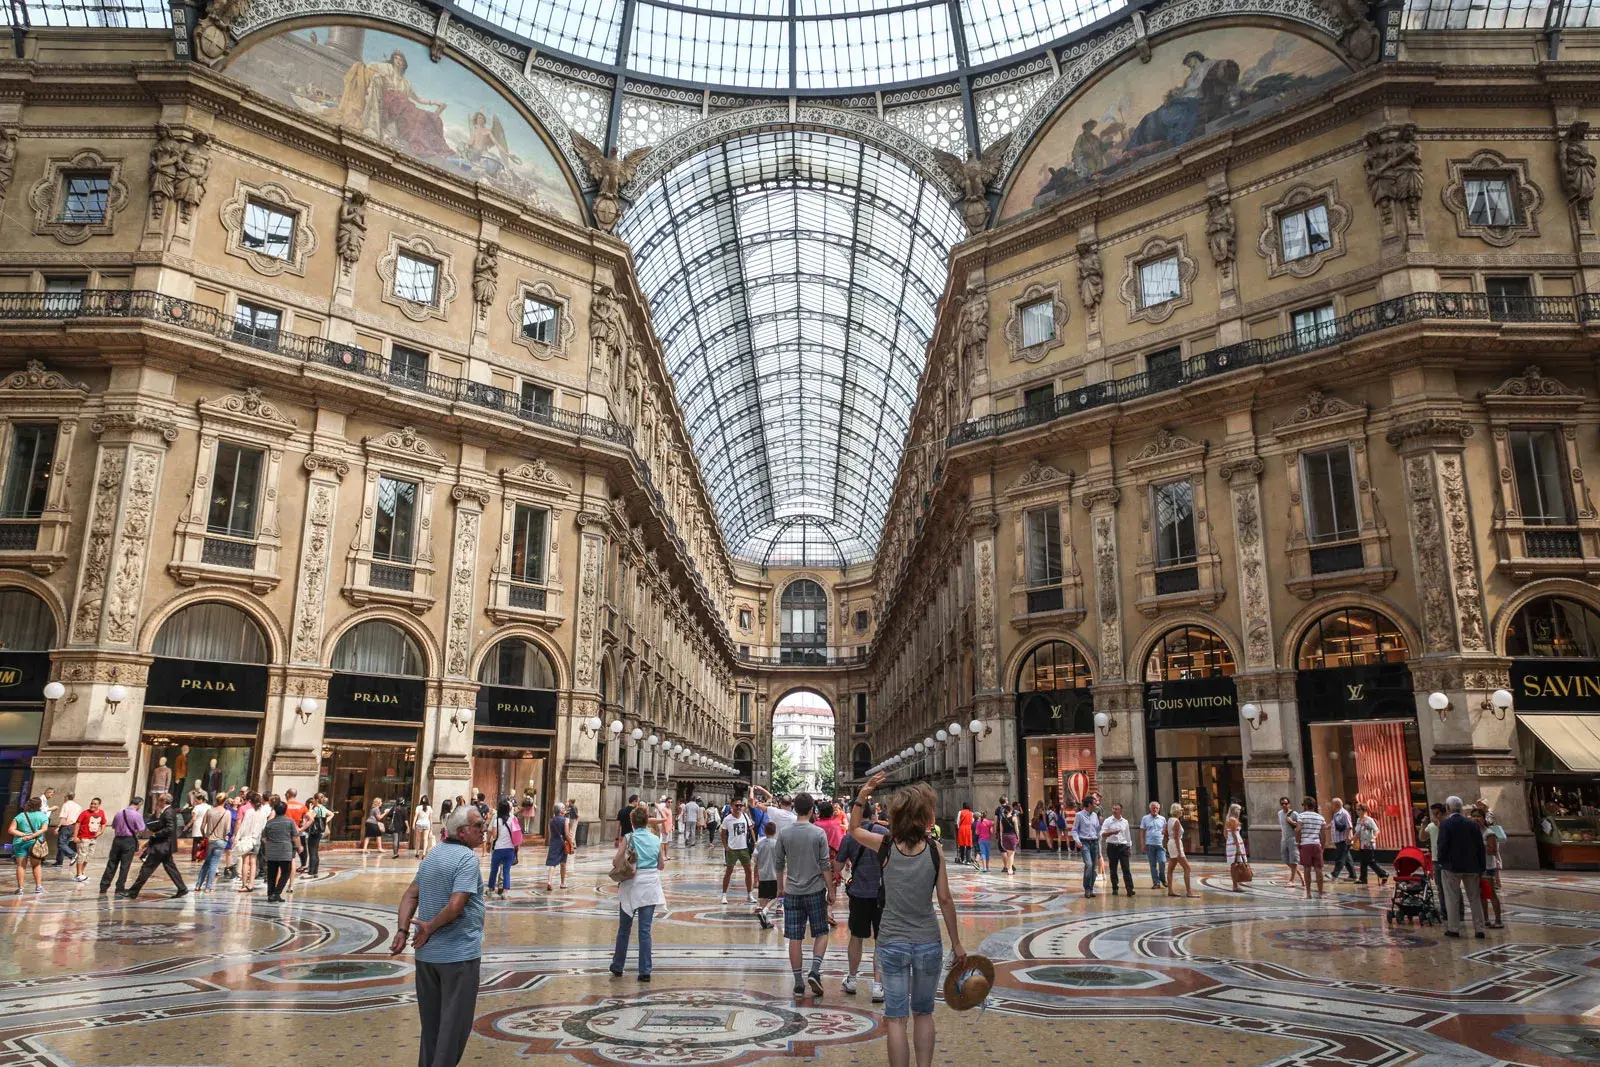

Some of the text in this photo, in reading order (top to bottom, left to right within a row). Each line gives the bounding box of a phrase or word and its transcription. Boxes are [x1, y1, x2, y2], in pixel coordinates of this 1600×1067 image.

[181, 679, 236, 692] PRADA
[1523, 675, 1600, 697] SAVIN
[354, 692, 399, 704] PRADA
[1154, 696, 1232, 710] LOUIS VUITTON
[497, 703, 536, 714] PRADA
